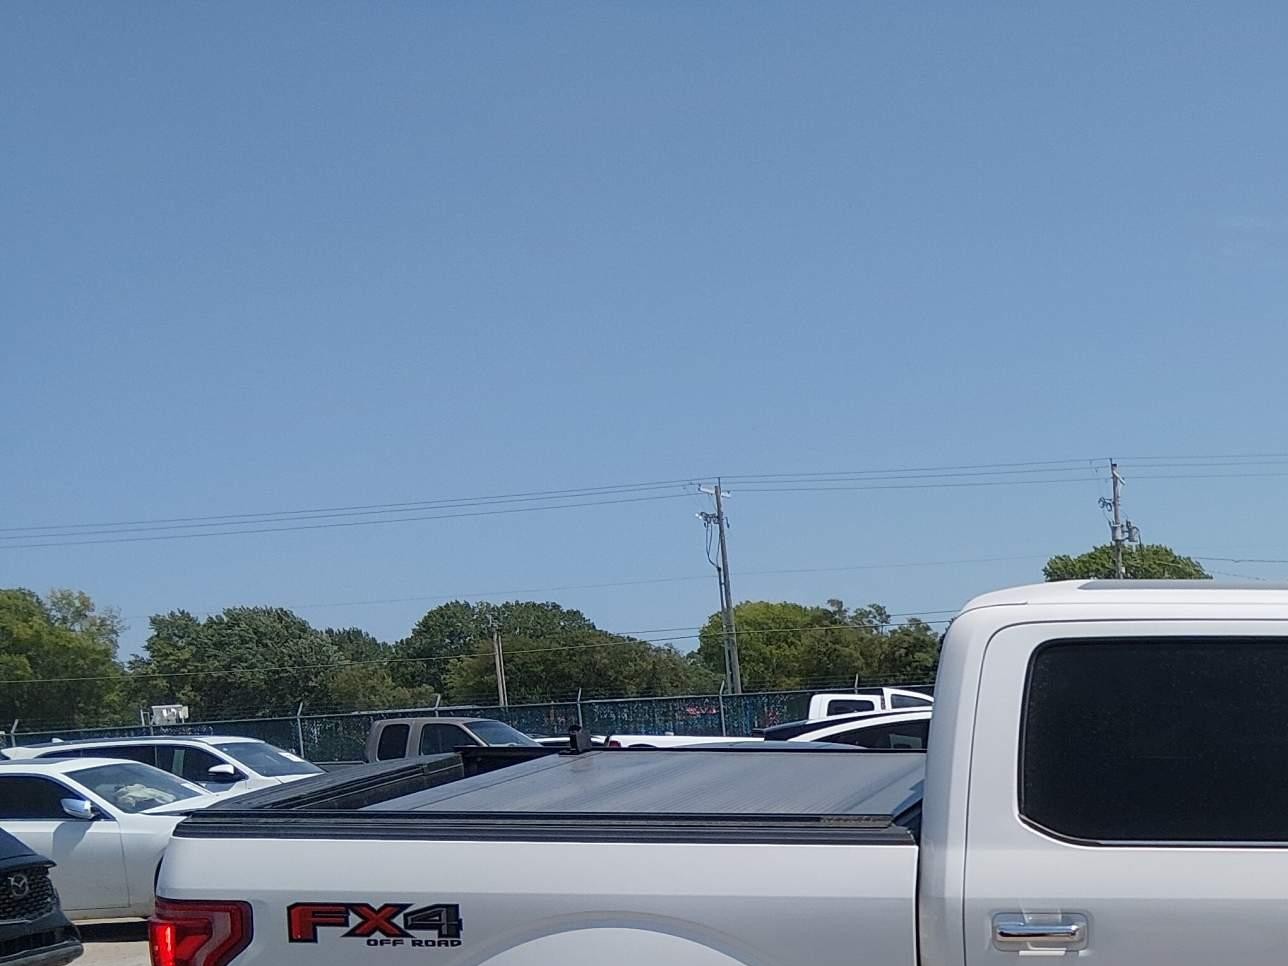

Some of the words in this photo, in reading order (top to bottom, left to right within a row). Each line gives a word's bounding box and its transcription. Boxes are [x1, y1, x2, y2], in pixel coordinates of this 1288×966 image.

[286, 902, 463, 943] FX4
[367, 939, 405, 947] OFF
[411, 939, 462, 947] ROAD
